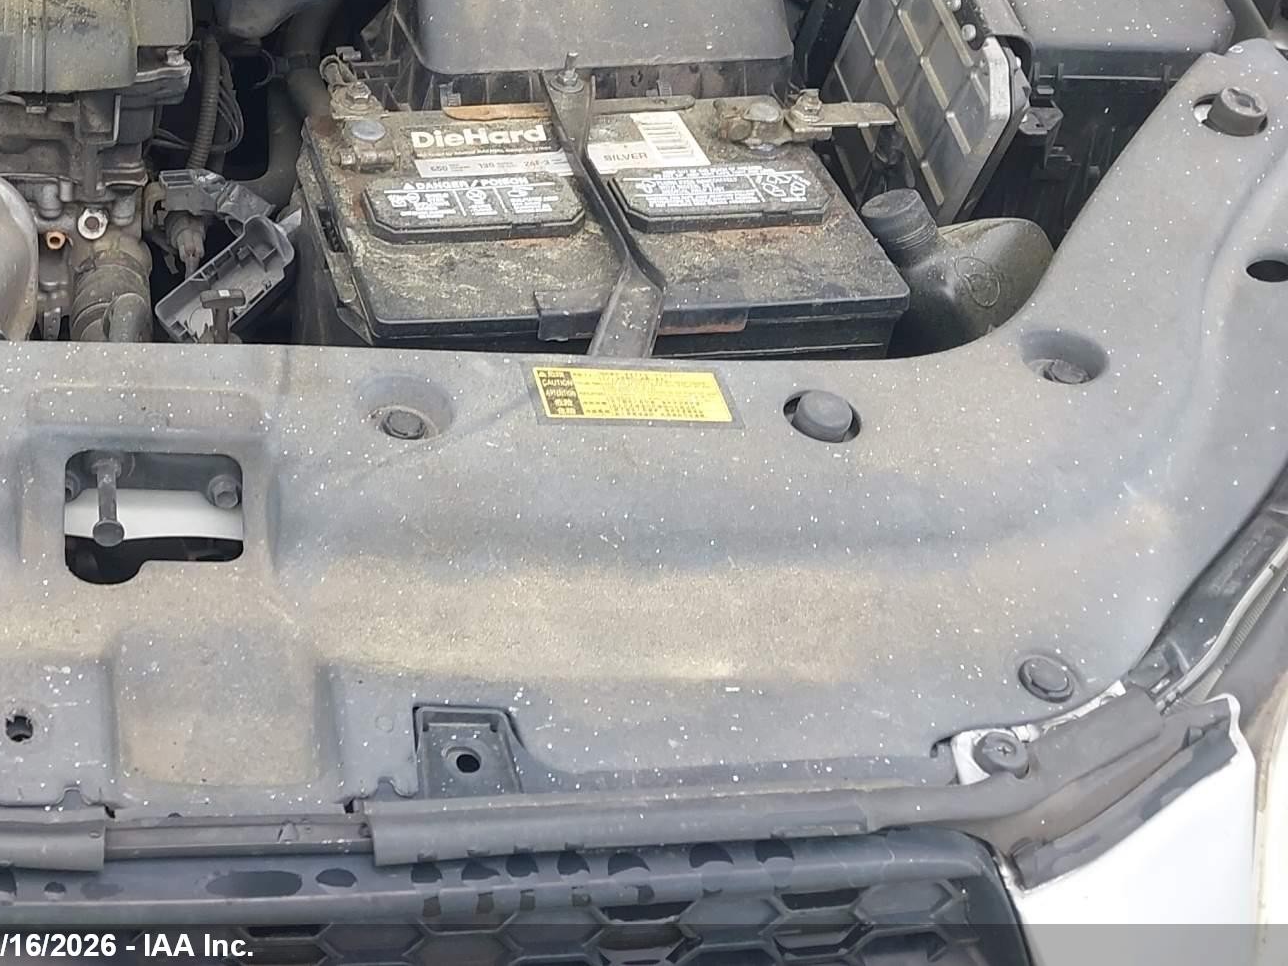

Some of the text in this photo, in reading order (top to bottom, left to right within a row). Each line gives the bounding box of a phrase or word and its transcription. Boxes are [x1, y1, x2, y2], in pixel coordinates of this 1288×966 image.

[410, 125, 547, 148] DieHard
[602, 151, 649, 163] SILVER
[415, 180, 469, 191] DANGER
[541, 378, 574, 388] CAUTION
